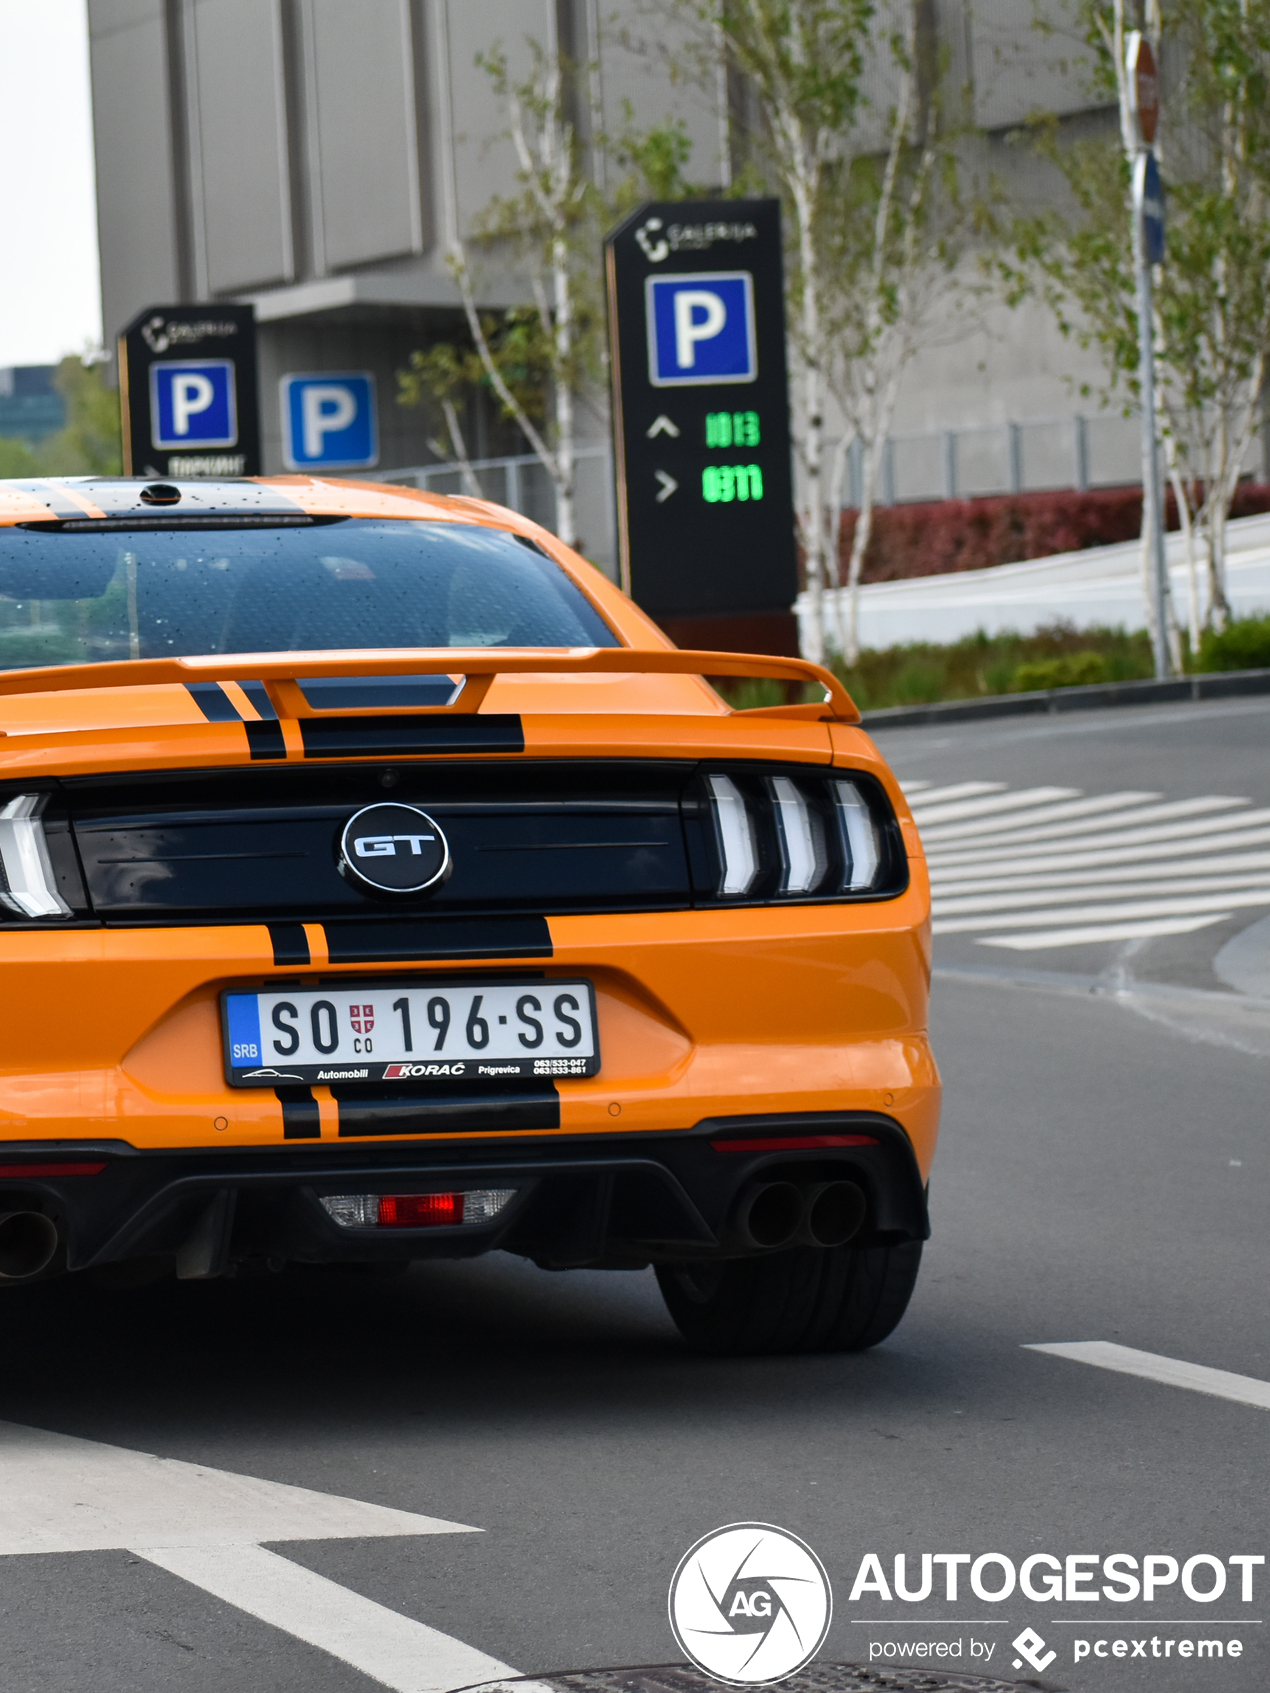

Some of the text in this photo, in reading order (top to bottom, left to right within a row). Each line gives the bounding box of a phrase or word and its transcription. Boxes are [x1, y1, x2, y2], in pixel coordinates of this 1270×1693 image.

[674, 289, 726, 369] P
[171, 373, 214, 436] P
[301, 384, 357, 459] P
[354, 835, 435, 857] GT
[271, 1000, 339, 1057] SO
[233, 1043, 258, 1059] SRB
[317, 1062, 520, 1080] Automobili KORAĆ Prigrevica
[533, 1059, 586, 1067] 063/533-047
[533, 1067, 586, 1075] 063/533-861
